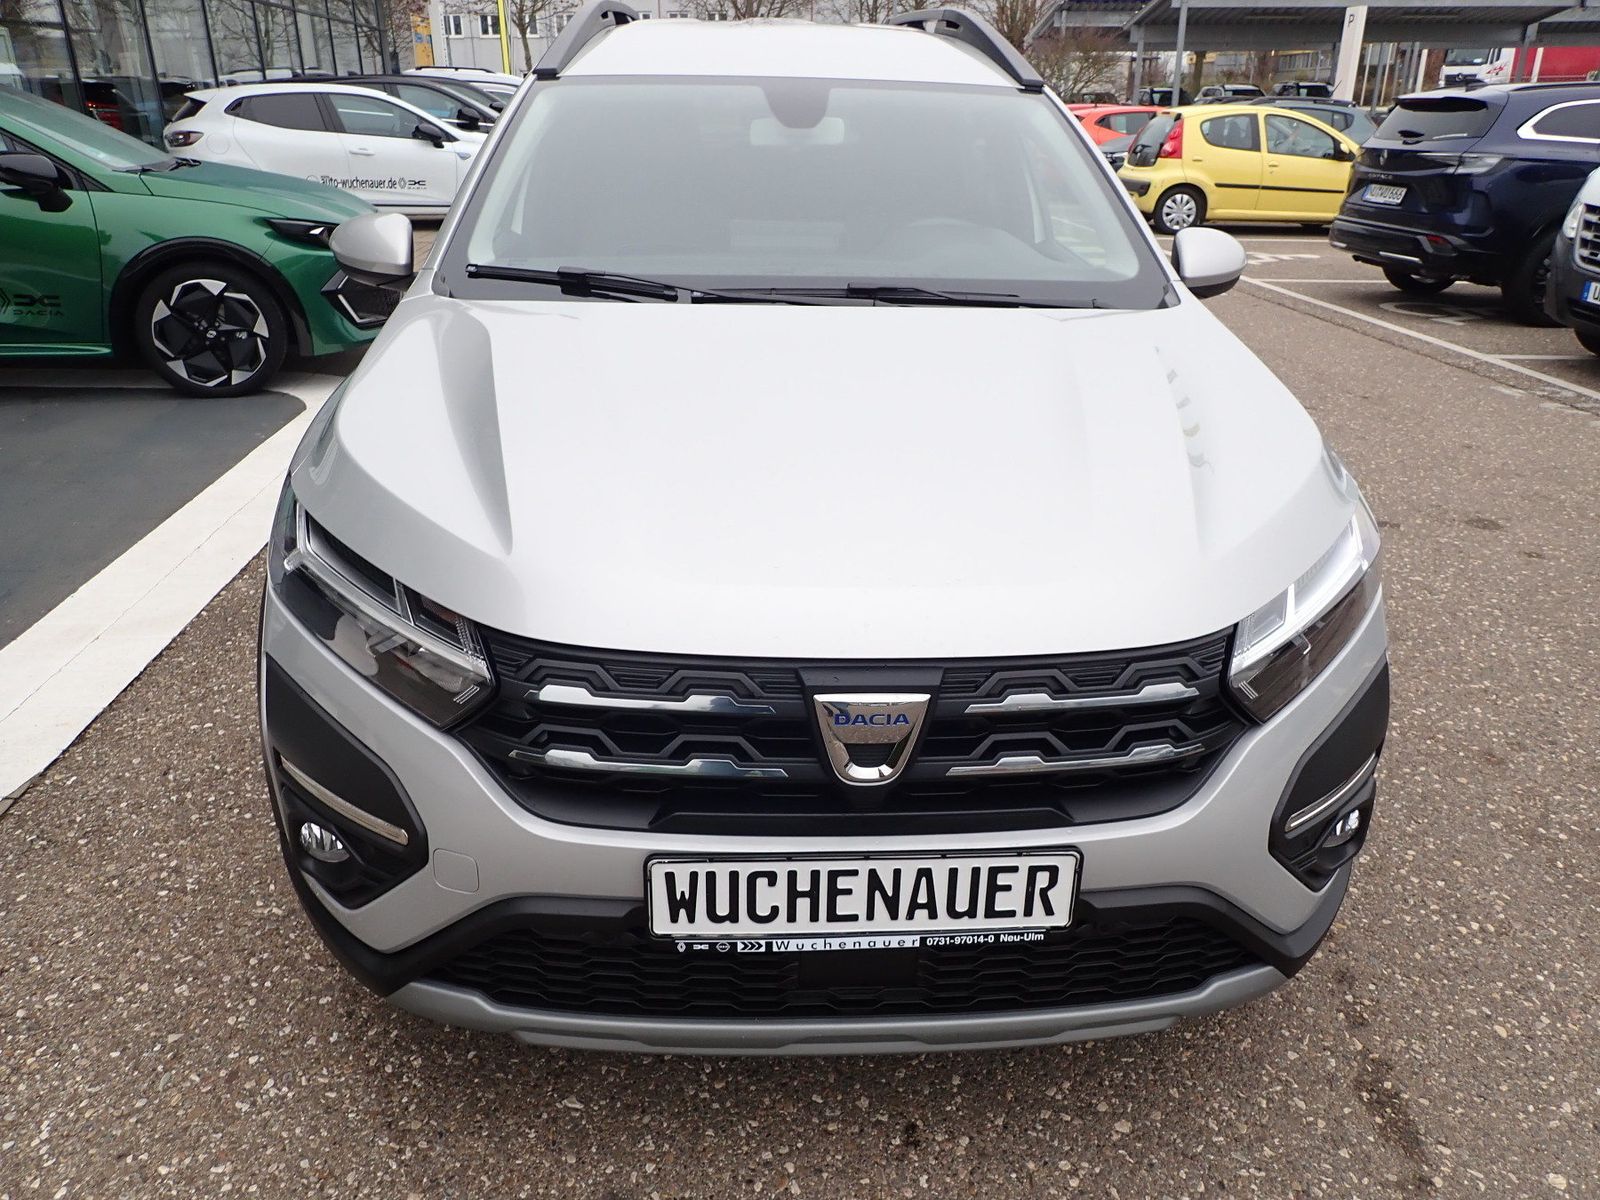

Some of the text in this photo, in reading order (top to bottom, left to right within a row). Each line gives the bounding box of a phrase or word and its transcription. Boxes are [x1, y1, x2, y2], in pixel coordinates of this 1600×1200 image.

[1348, 14, 1355, 27] P
[834, 713, 910, 726] DACIA
[664, 865, 1060, 923] WUCHENAUER
[775, 932, 1045, 951] Wuchenauer 0731-97014-0 Neu-Ulm
